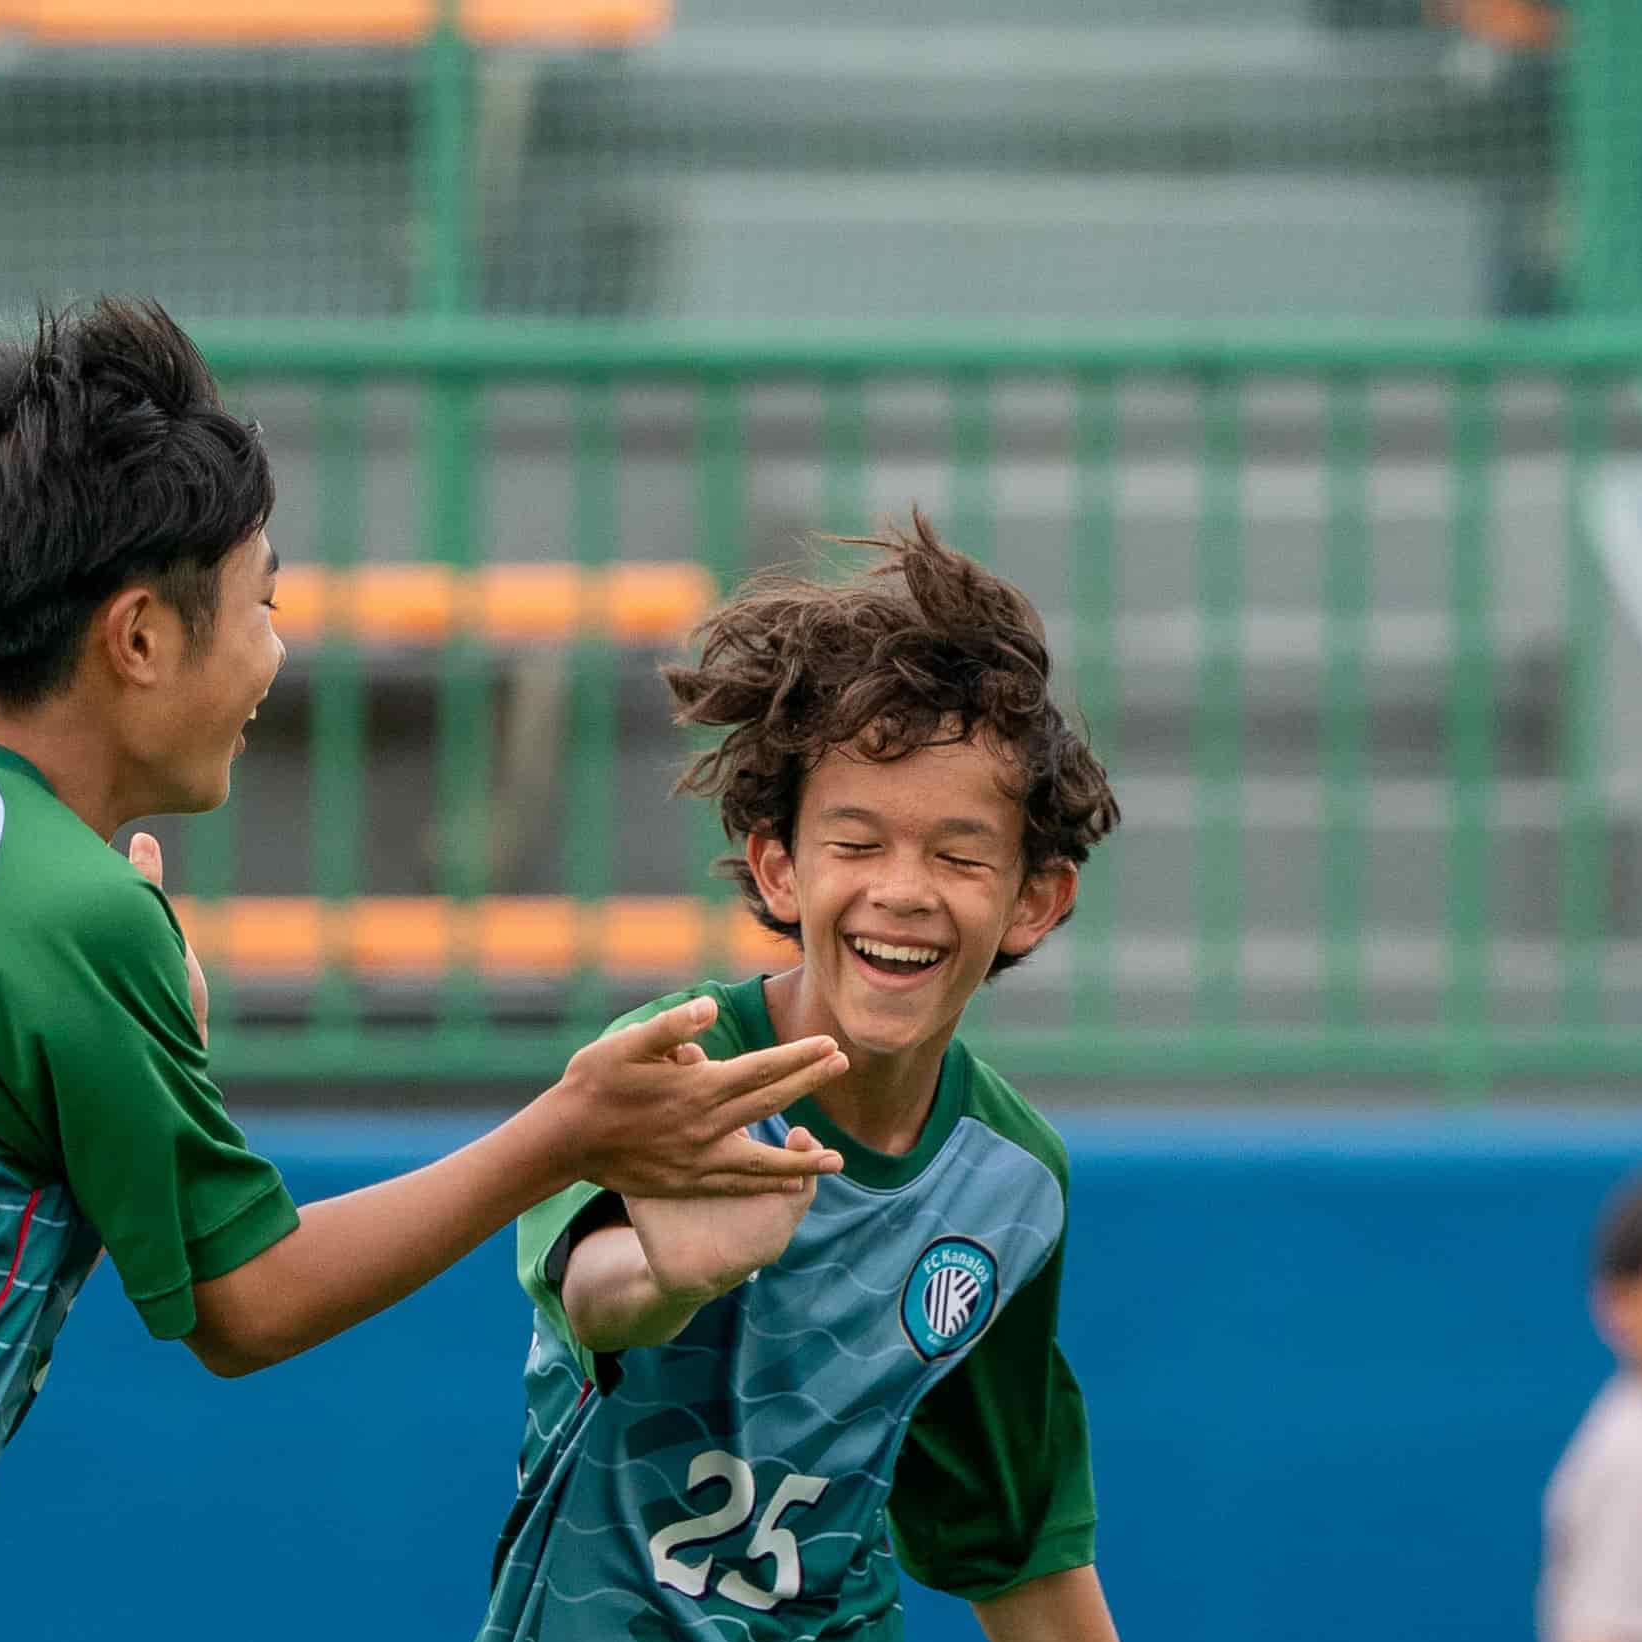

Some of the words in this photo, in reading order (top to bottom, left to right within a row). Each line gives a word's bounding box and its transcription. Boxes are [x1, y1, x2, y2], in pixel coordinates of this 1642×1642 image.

[923, 1253, 942, 1275] FC
[941, 1248, 991, 1285] Kanaloa
[648, 1449, 831, 1612] 25
